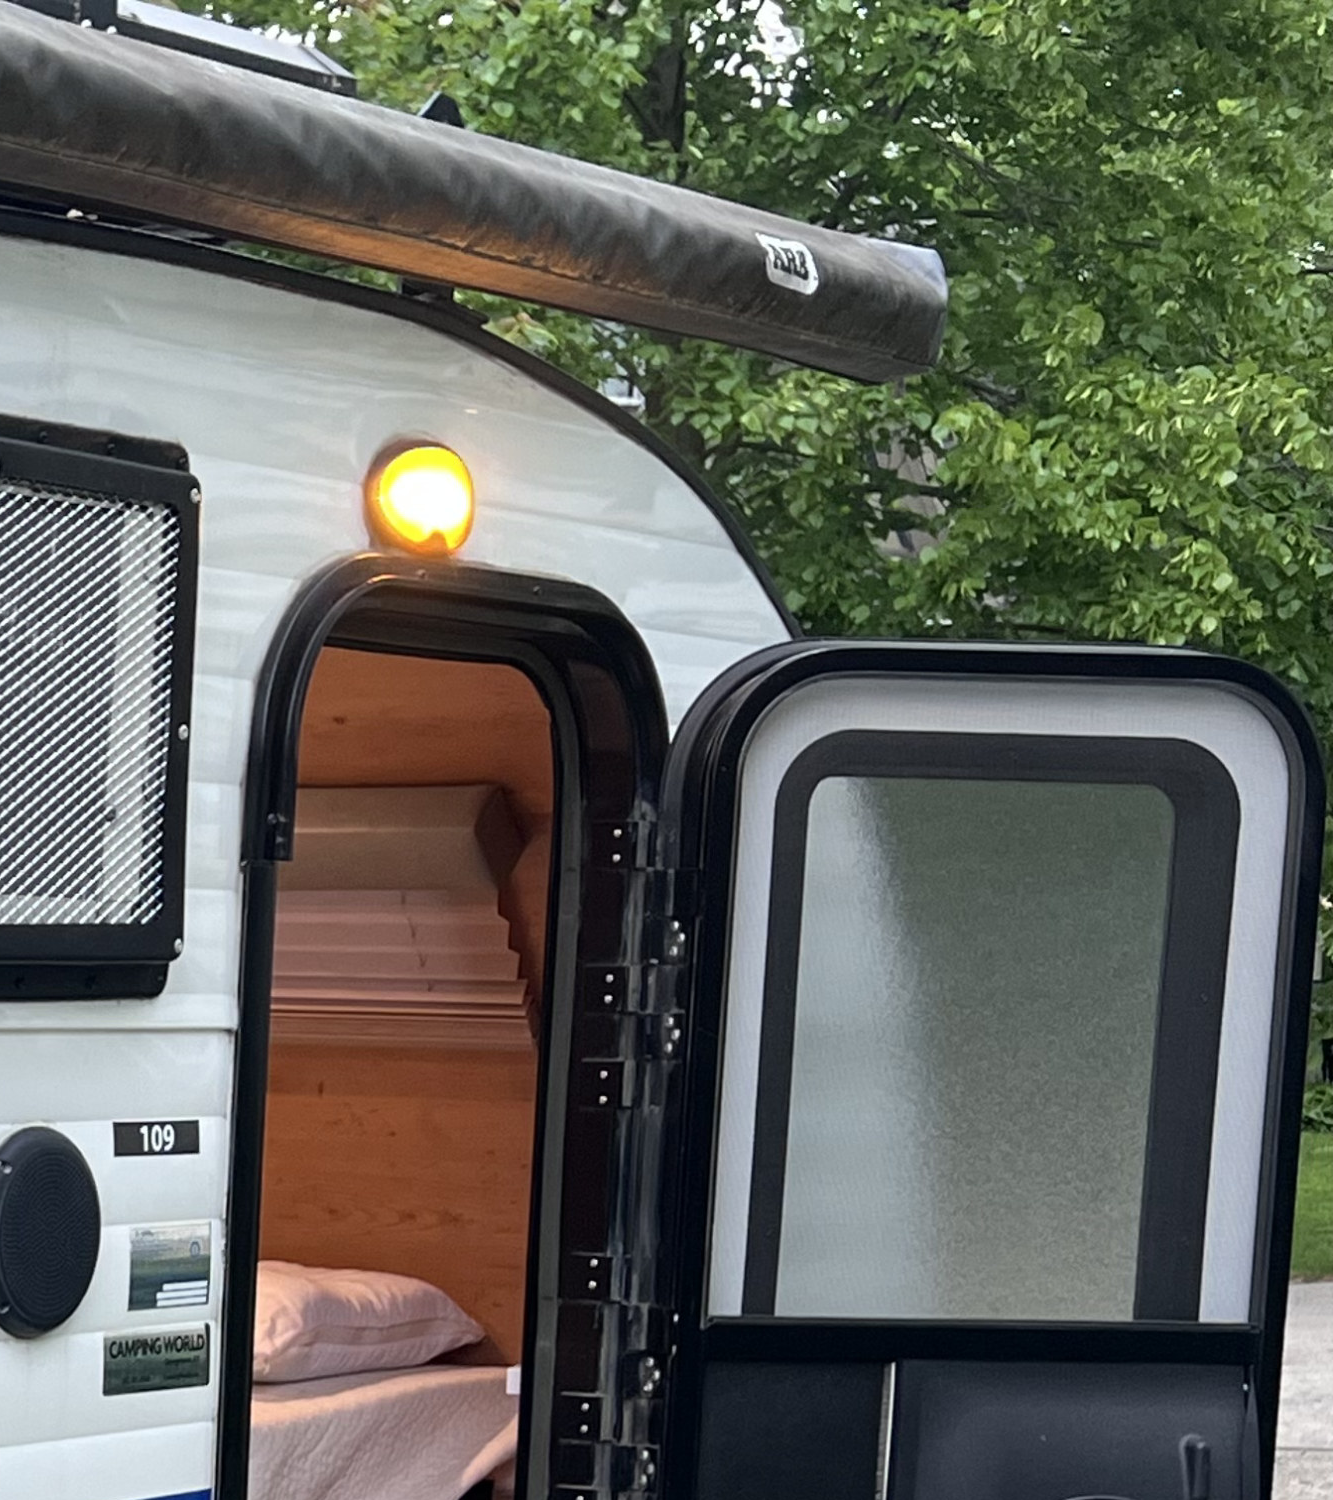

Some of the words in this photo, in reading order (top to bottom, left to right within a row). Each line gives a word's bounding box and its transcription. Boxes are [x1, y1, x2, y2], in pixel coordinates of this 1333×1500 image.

[767, 244, 809, 281] ARB
[139, 1124, 175, 1153] 109
[108, 1337, 162, 1360] CAMPING
[163, 1333, 206, 1353] WORLD
